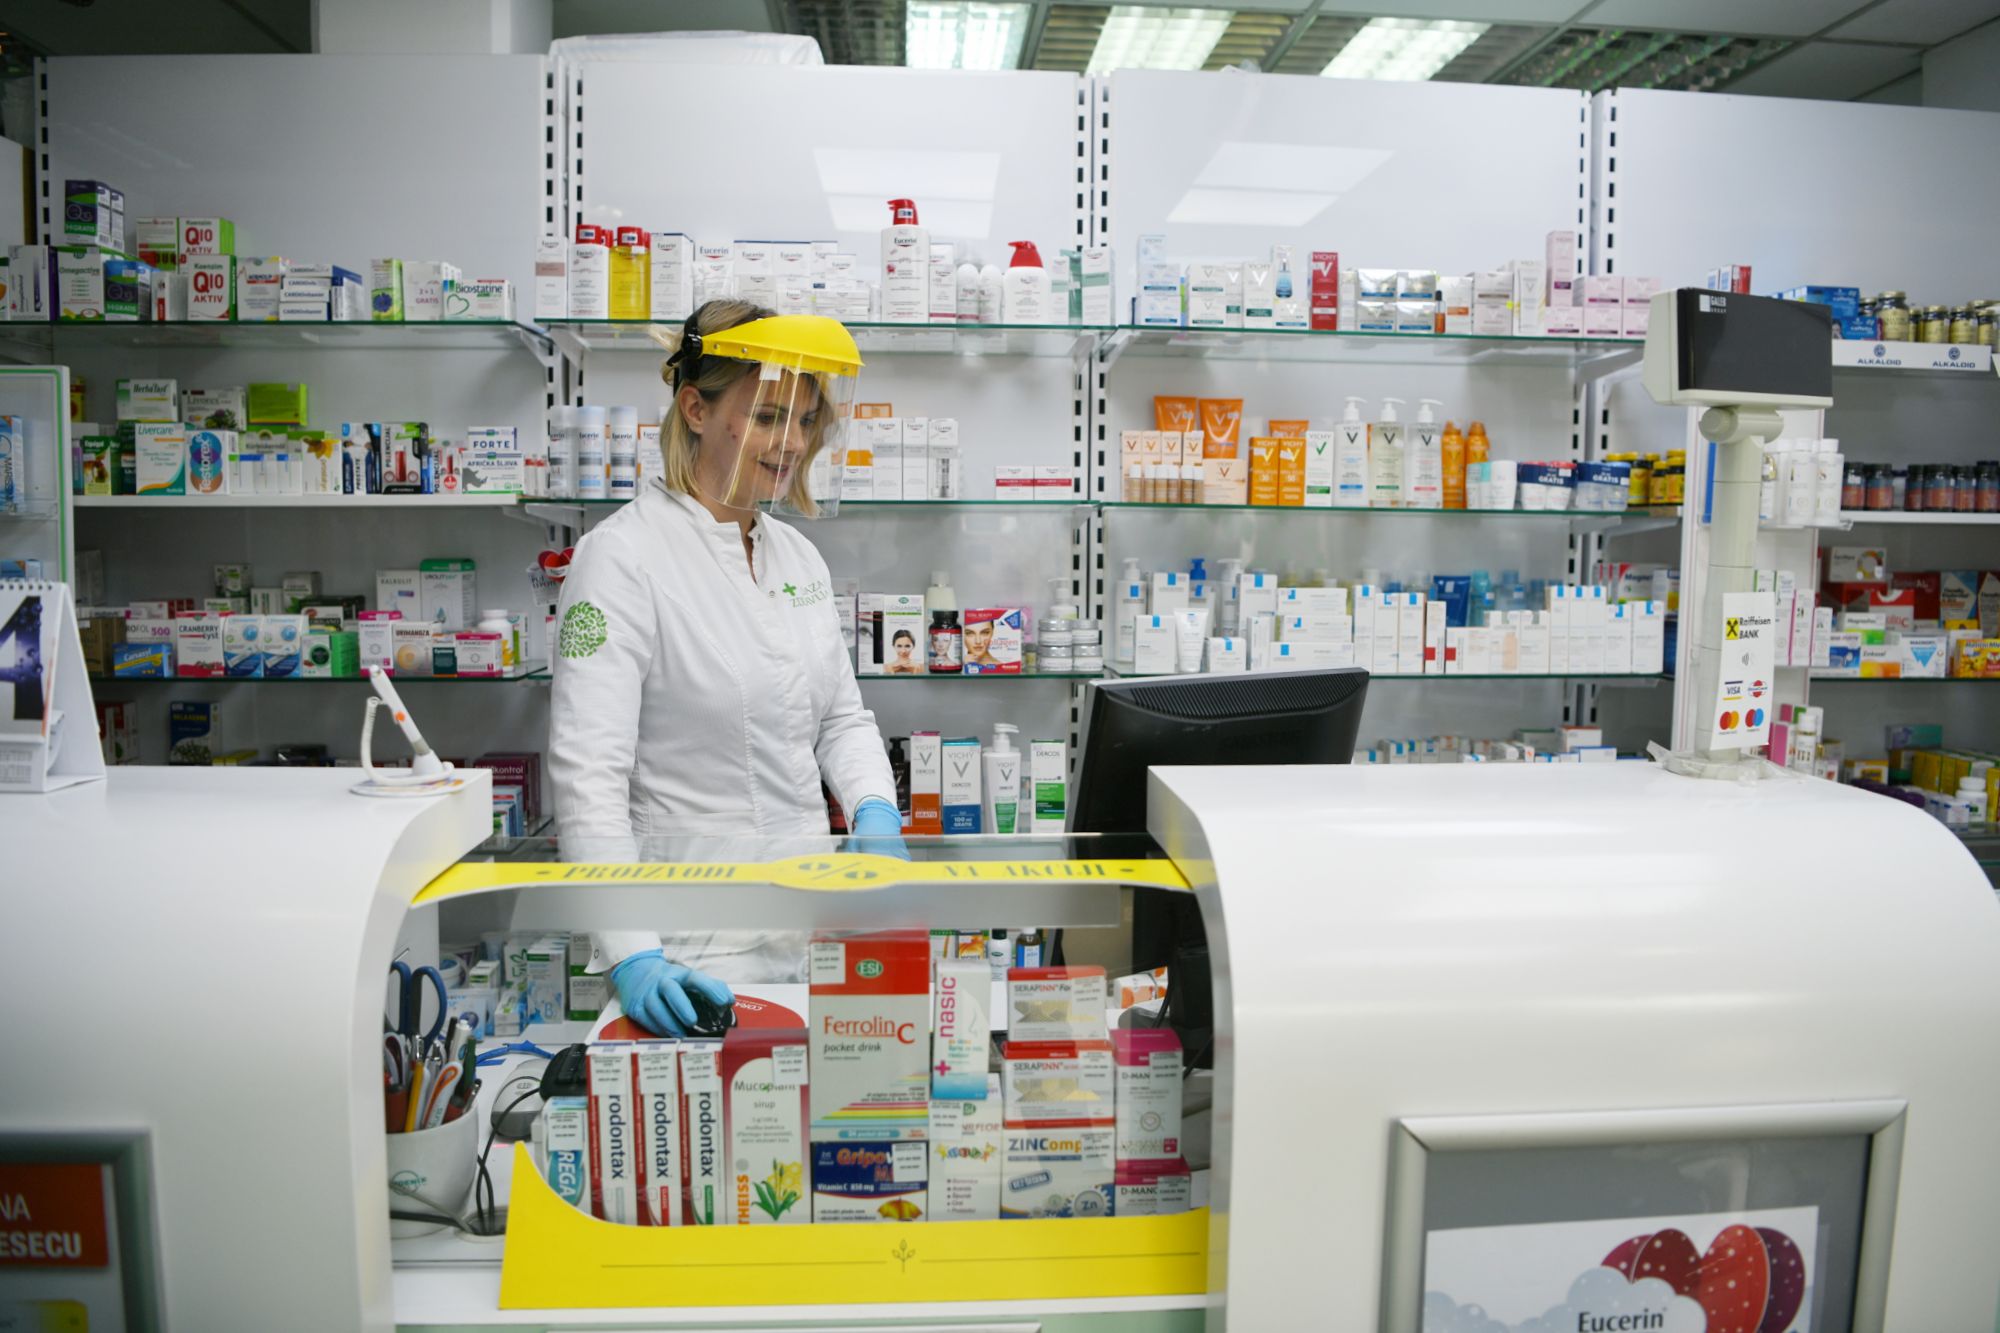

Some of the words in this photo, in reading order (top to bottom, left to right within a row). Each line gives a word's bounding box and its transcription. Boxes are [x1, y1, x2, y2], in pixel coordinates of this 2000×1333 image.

[185, 227, 213, 246] Q10
[894, 236, 918, 245] Eucerin
[699, 245, 729, 256] Eucerin
[1312, 253, 1337, 261] VICHY
[193, 271, 224, 294] Q10
[193, 296, 223, 304] AKTIV
[1932, 360, 1976, 368] ALKALOID
[137, 425, 175, 436] Livercare
[1346, 432, 1358, 444] V
[1384, 432, 1396, 444] V
[1421, 434, 1433, 446] V
[473, 440, 510, 449] FORTE
[200, 436, 212, 491] restorex
[467, 458, 496, 467] AFRIČKA
[496, 458, 518, 467] ŠLJIVA
[1538, 476, 1564, 485] GRATIS
[1592, 474, 1619, 483] GRATIS
[1739, 615, 1771, 626] Raiffeisen
[152, 627, 171, 636] 500
[178, 624, 219, 633] CRANBERRY
[202, 631, 220, 640] cyst
[1739, 630, 1760, 639] BANK
[1726, 686, 1741, 695] VISA
[919, 753, 932, 767] V
[947, 752, 975, 760] VICHY
[953, 761, 970, 778] V
[1001, 769, 1013, 782] V
[563, 865, 737, 880] PROIZVODI
[860, 963, 880, 974] ESI
[939, 977, 956, 1038] nasic
[823, 1015, 896, 1034] Ferrolin
[896, 1022, 915, 1044] C
[823, 1043, 855, 1054] pocket
[857, 1042, 882, 1052] drink
[753, 1099, 776, 1110] sirup
[653, 1092, 672, 1178] rodontax
[698, 1091, 716, 1177] rodontax
[817, 1182, 842, 1191] Vitamin
[737, 1173, 750, 1225] THEISS
[1082, 1200, 1098, 1211] Zn
[1576, 1309, 1666, 1333] Eucerin
